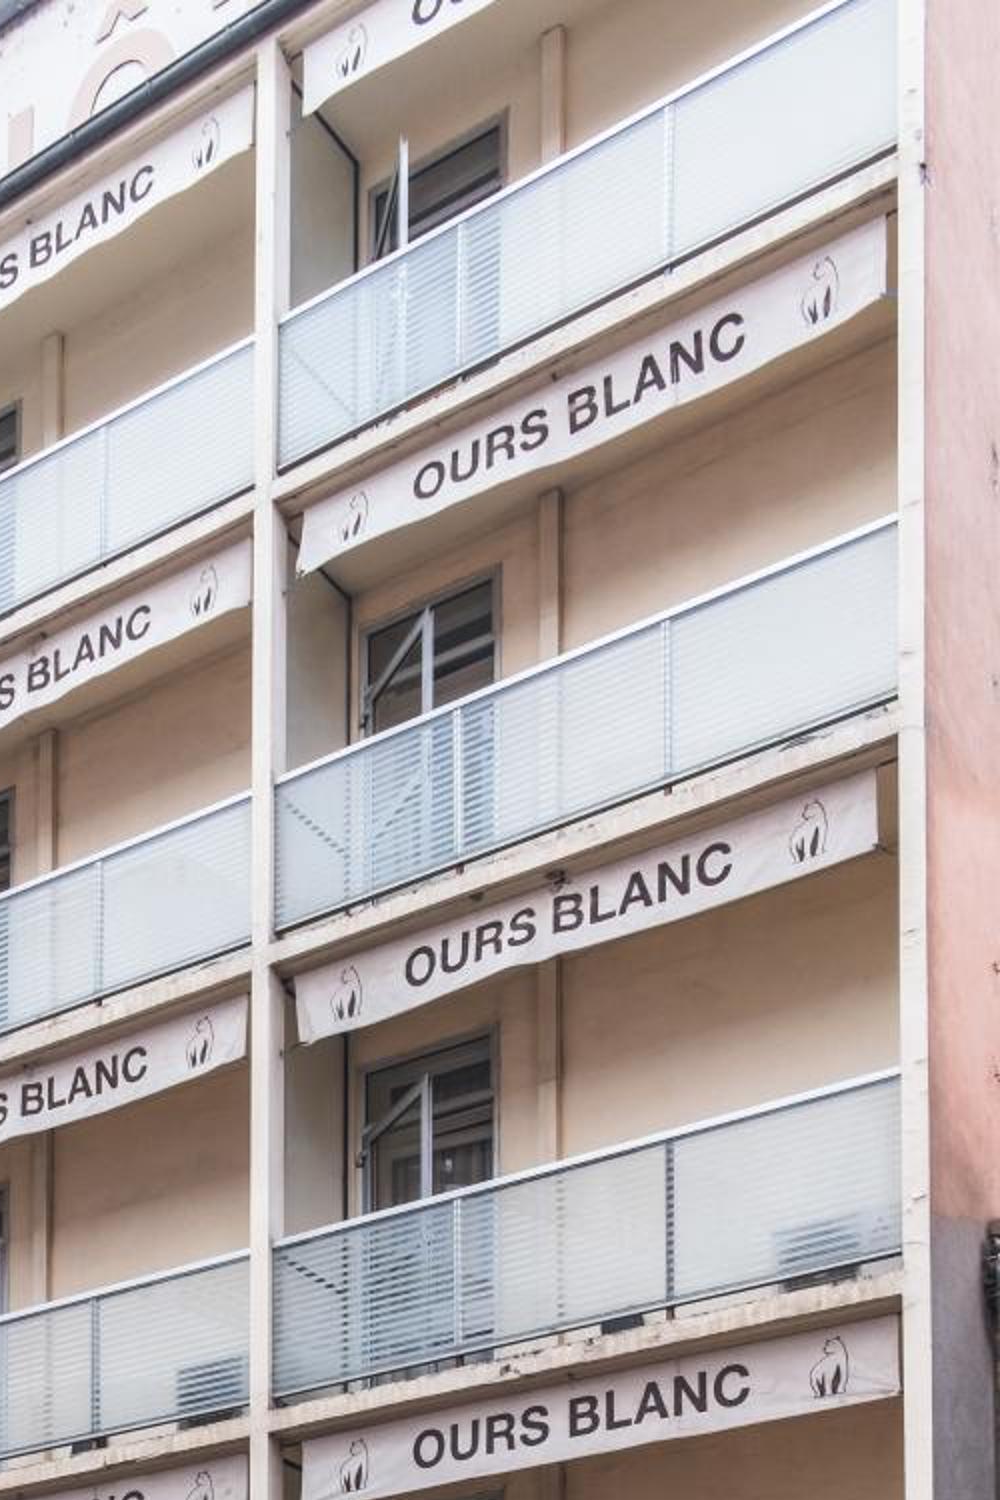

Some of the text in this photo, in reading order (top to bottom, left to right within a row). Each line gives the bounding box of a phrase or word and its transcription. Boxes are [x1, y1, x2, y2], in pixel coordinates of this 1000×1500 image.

[28, 164, 154, 270] BLANC
[411, 311, 747, 500] OURS BLANC
[26, 604, 151, 695] BLANC
[404, 839, 733, 989] OURS BLANC
[20, 1046, 148, 1118] BLANC
[413, 1363, 751, 1472] OURS BLANC
